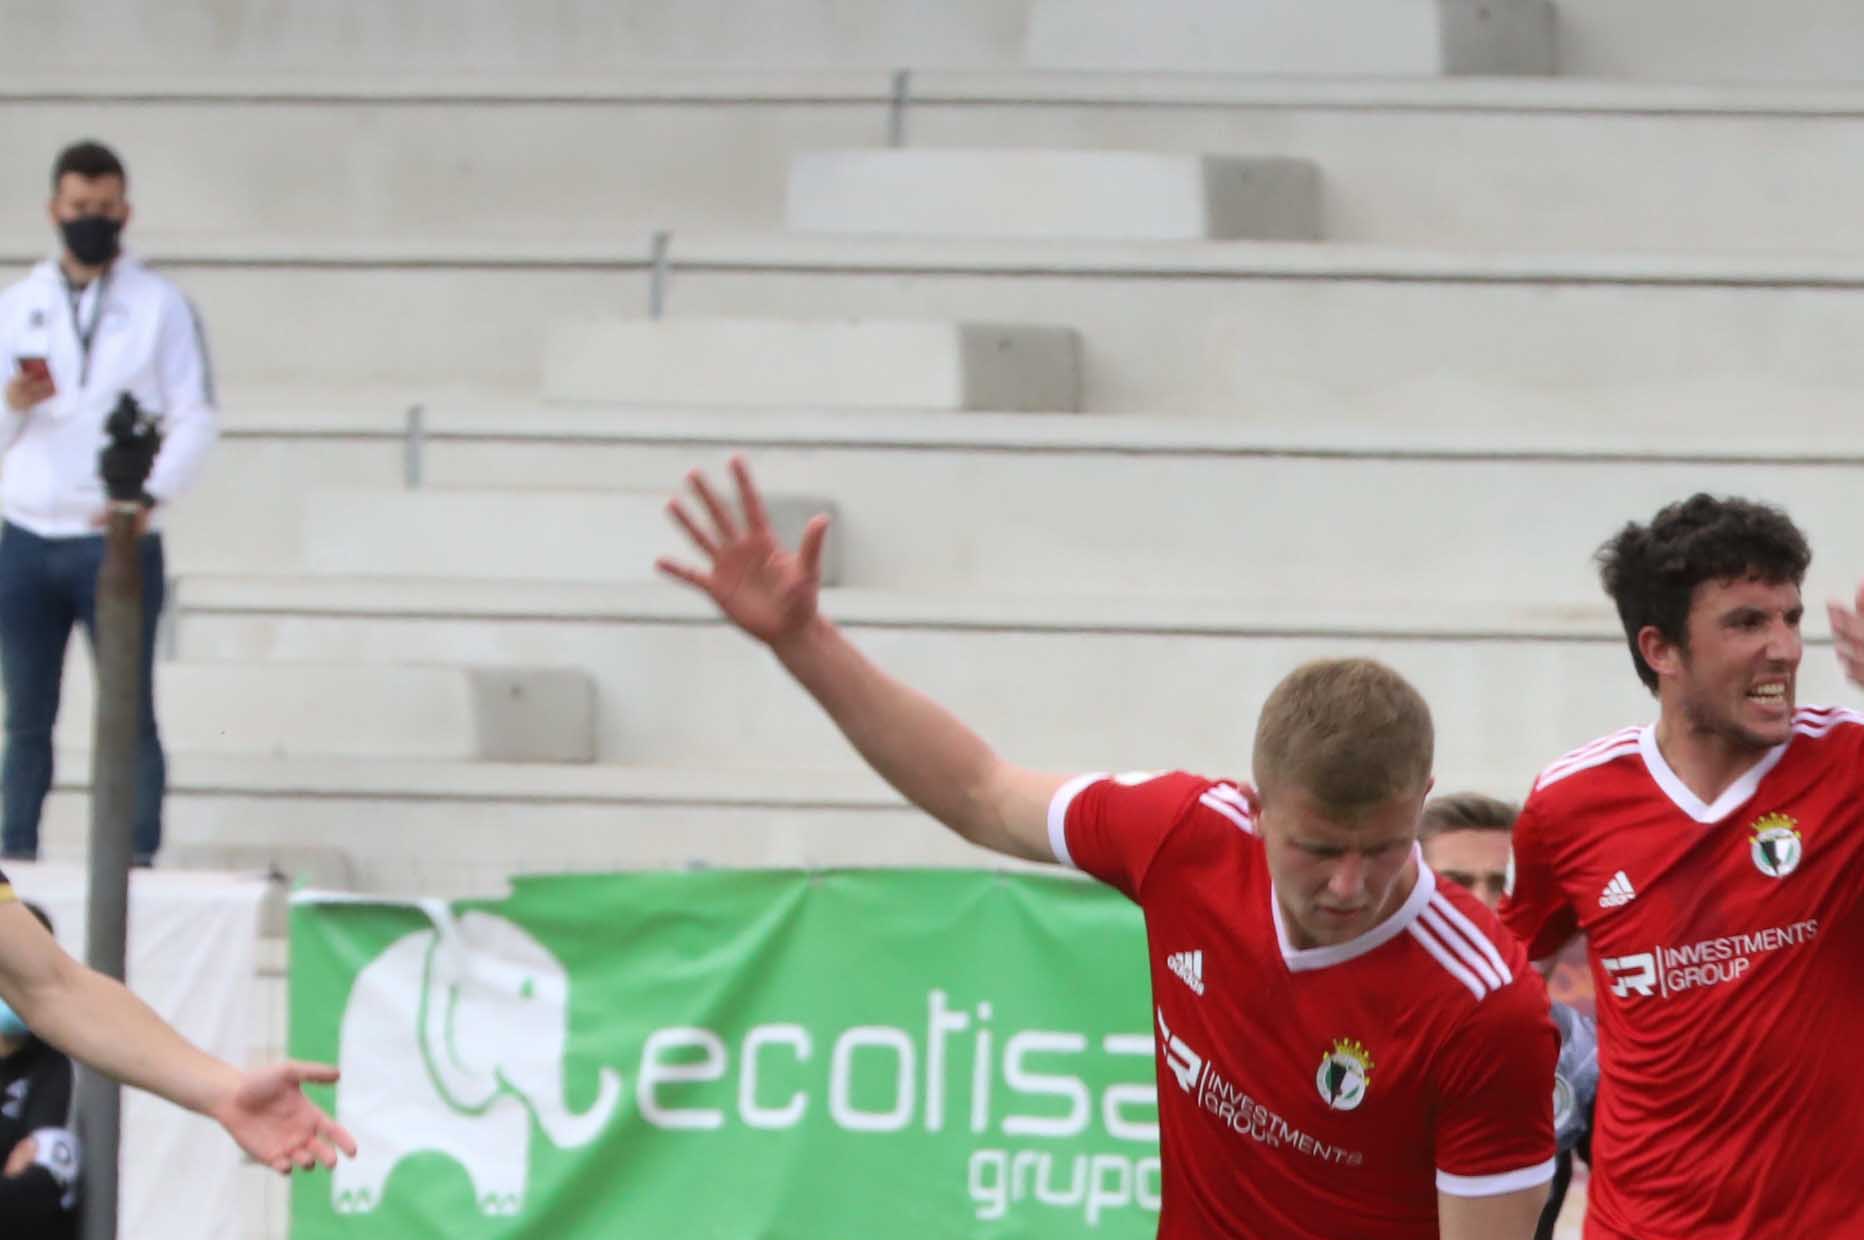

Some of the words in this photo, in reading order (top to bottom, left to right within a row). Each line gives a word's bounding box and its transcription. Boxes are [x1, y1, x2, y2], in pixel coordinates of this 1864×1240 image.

[1664, 919, 1819, 968] INVESTMENTS
[1667, 957, 1750, 993] GROUP
[635, 988, 1160, 1141] ecotisa
[1208, 1071, 1363, 1166] INVESTMENTS
